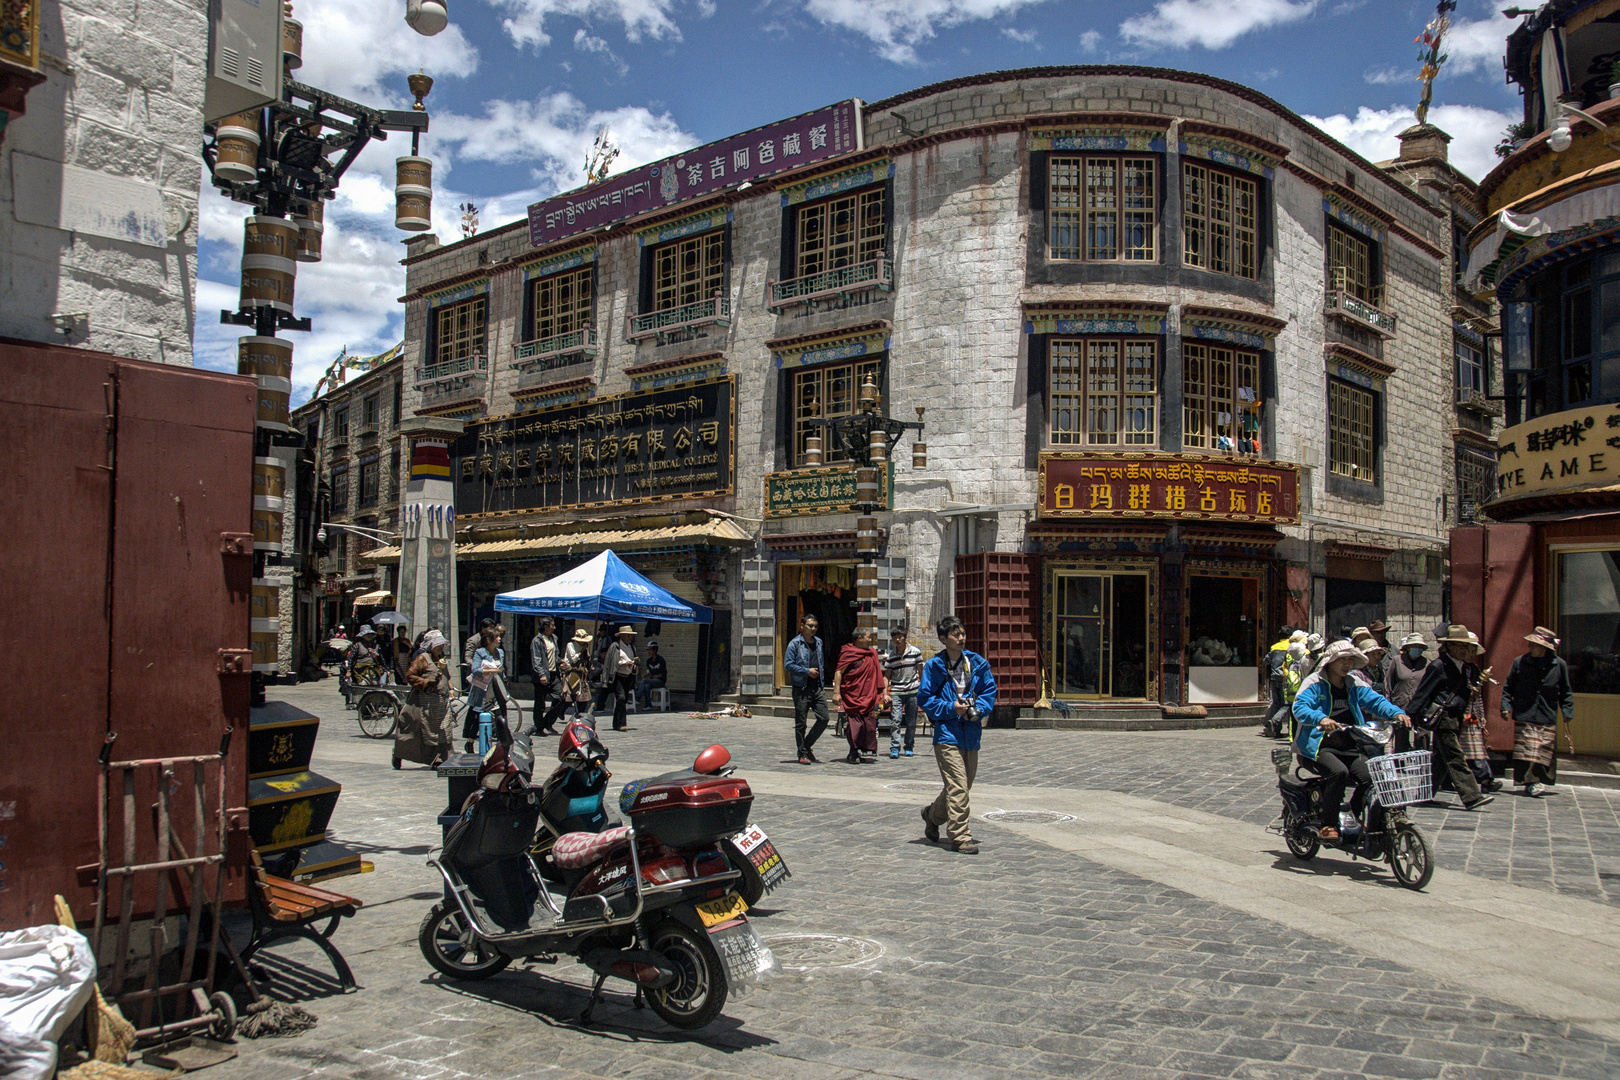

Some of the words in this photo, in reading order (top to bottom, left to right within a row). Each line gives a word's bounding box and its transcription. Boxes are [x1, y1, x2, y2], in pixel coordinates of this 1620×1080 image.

[686, 124, 827, 187] 茶吉阿爸藏餐
[461, 421, 719, 478] 西藏藏医学院藏药有限公司
[648, 456, 681, 471] MEDICAL
[1540, 453, 1607, 480] AME
[1054, 483, 1273, 515] 白玛群措古玩店
[403, 503, 421, 523] 110
[428, 504, 455, 524] 110
[719, 932, 759, 957] 天能电池
